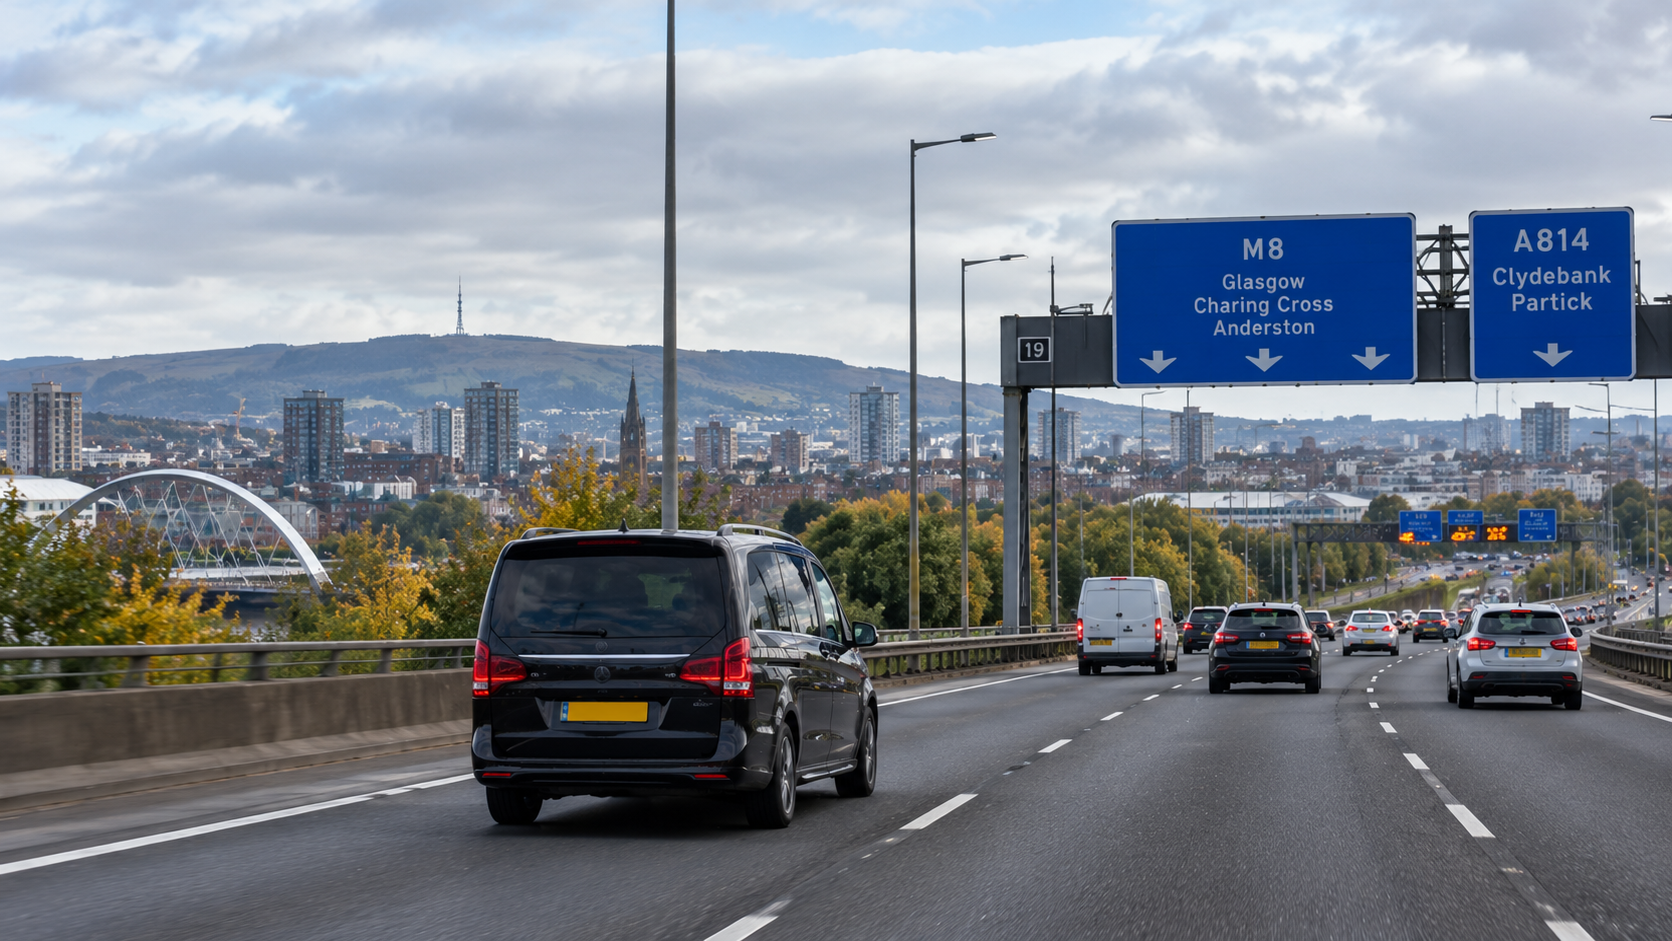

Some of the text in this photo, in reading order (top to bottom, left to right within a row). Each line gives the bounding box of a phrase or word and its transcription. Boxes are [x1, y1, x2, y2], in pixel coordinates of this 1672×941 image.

[1243, 237, 1284, 260] M8
[1514, 227, 1589, 252] A814
[1222, 273, 1305, 294] Glasgow
[1493, 265, 1611, 289] Clydebank
[1194, 296, 1333, 317] Charing Cross
[1512, 291, 1592, 312] Partick
[1213, 319, 1315, 336] Anderston
[1024, 342, 1044, 358] 19
